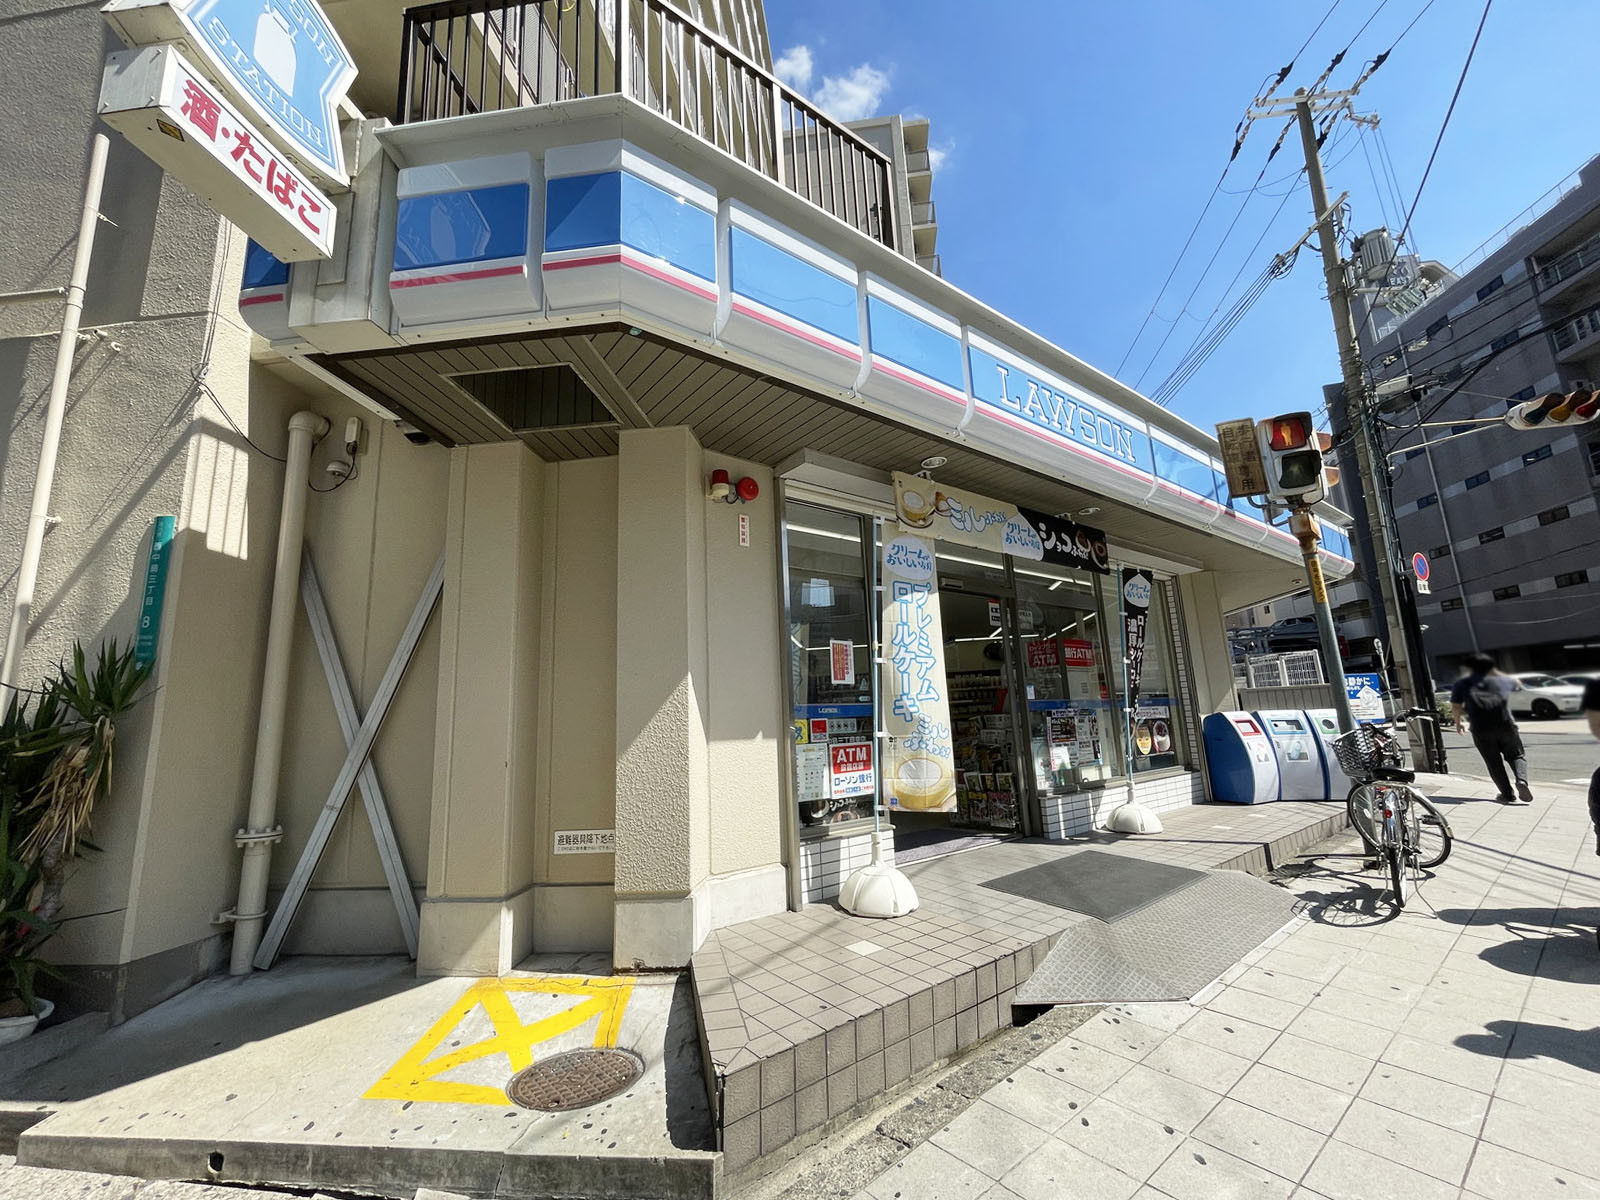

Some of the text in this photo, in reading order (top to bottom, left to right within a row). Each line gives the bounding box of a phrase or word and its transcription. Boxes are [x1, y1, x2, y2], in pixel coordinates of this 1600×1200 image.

[208, 17, 325, 149] STATION
[181, 79, 322, 236] 酒・たばこ
[996, 363, 1136, 463] LAWSON
[142, 616, 150, 628] 8
[892, 580, 920, 723] ロールケーキ
[912, 582, 940, 702] プレミアム
[834, 773, 873, 787] ローソン銀行
[836, 747, 868, 764] ATM
